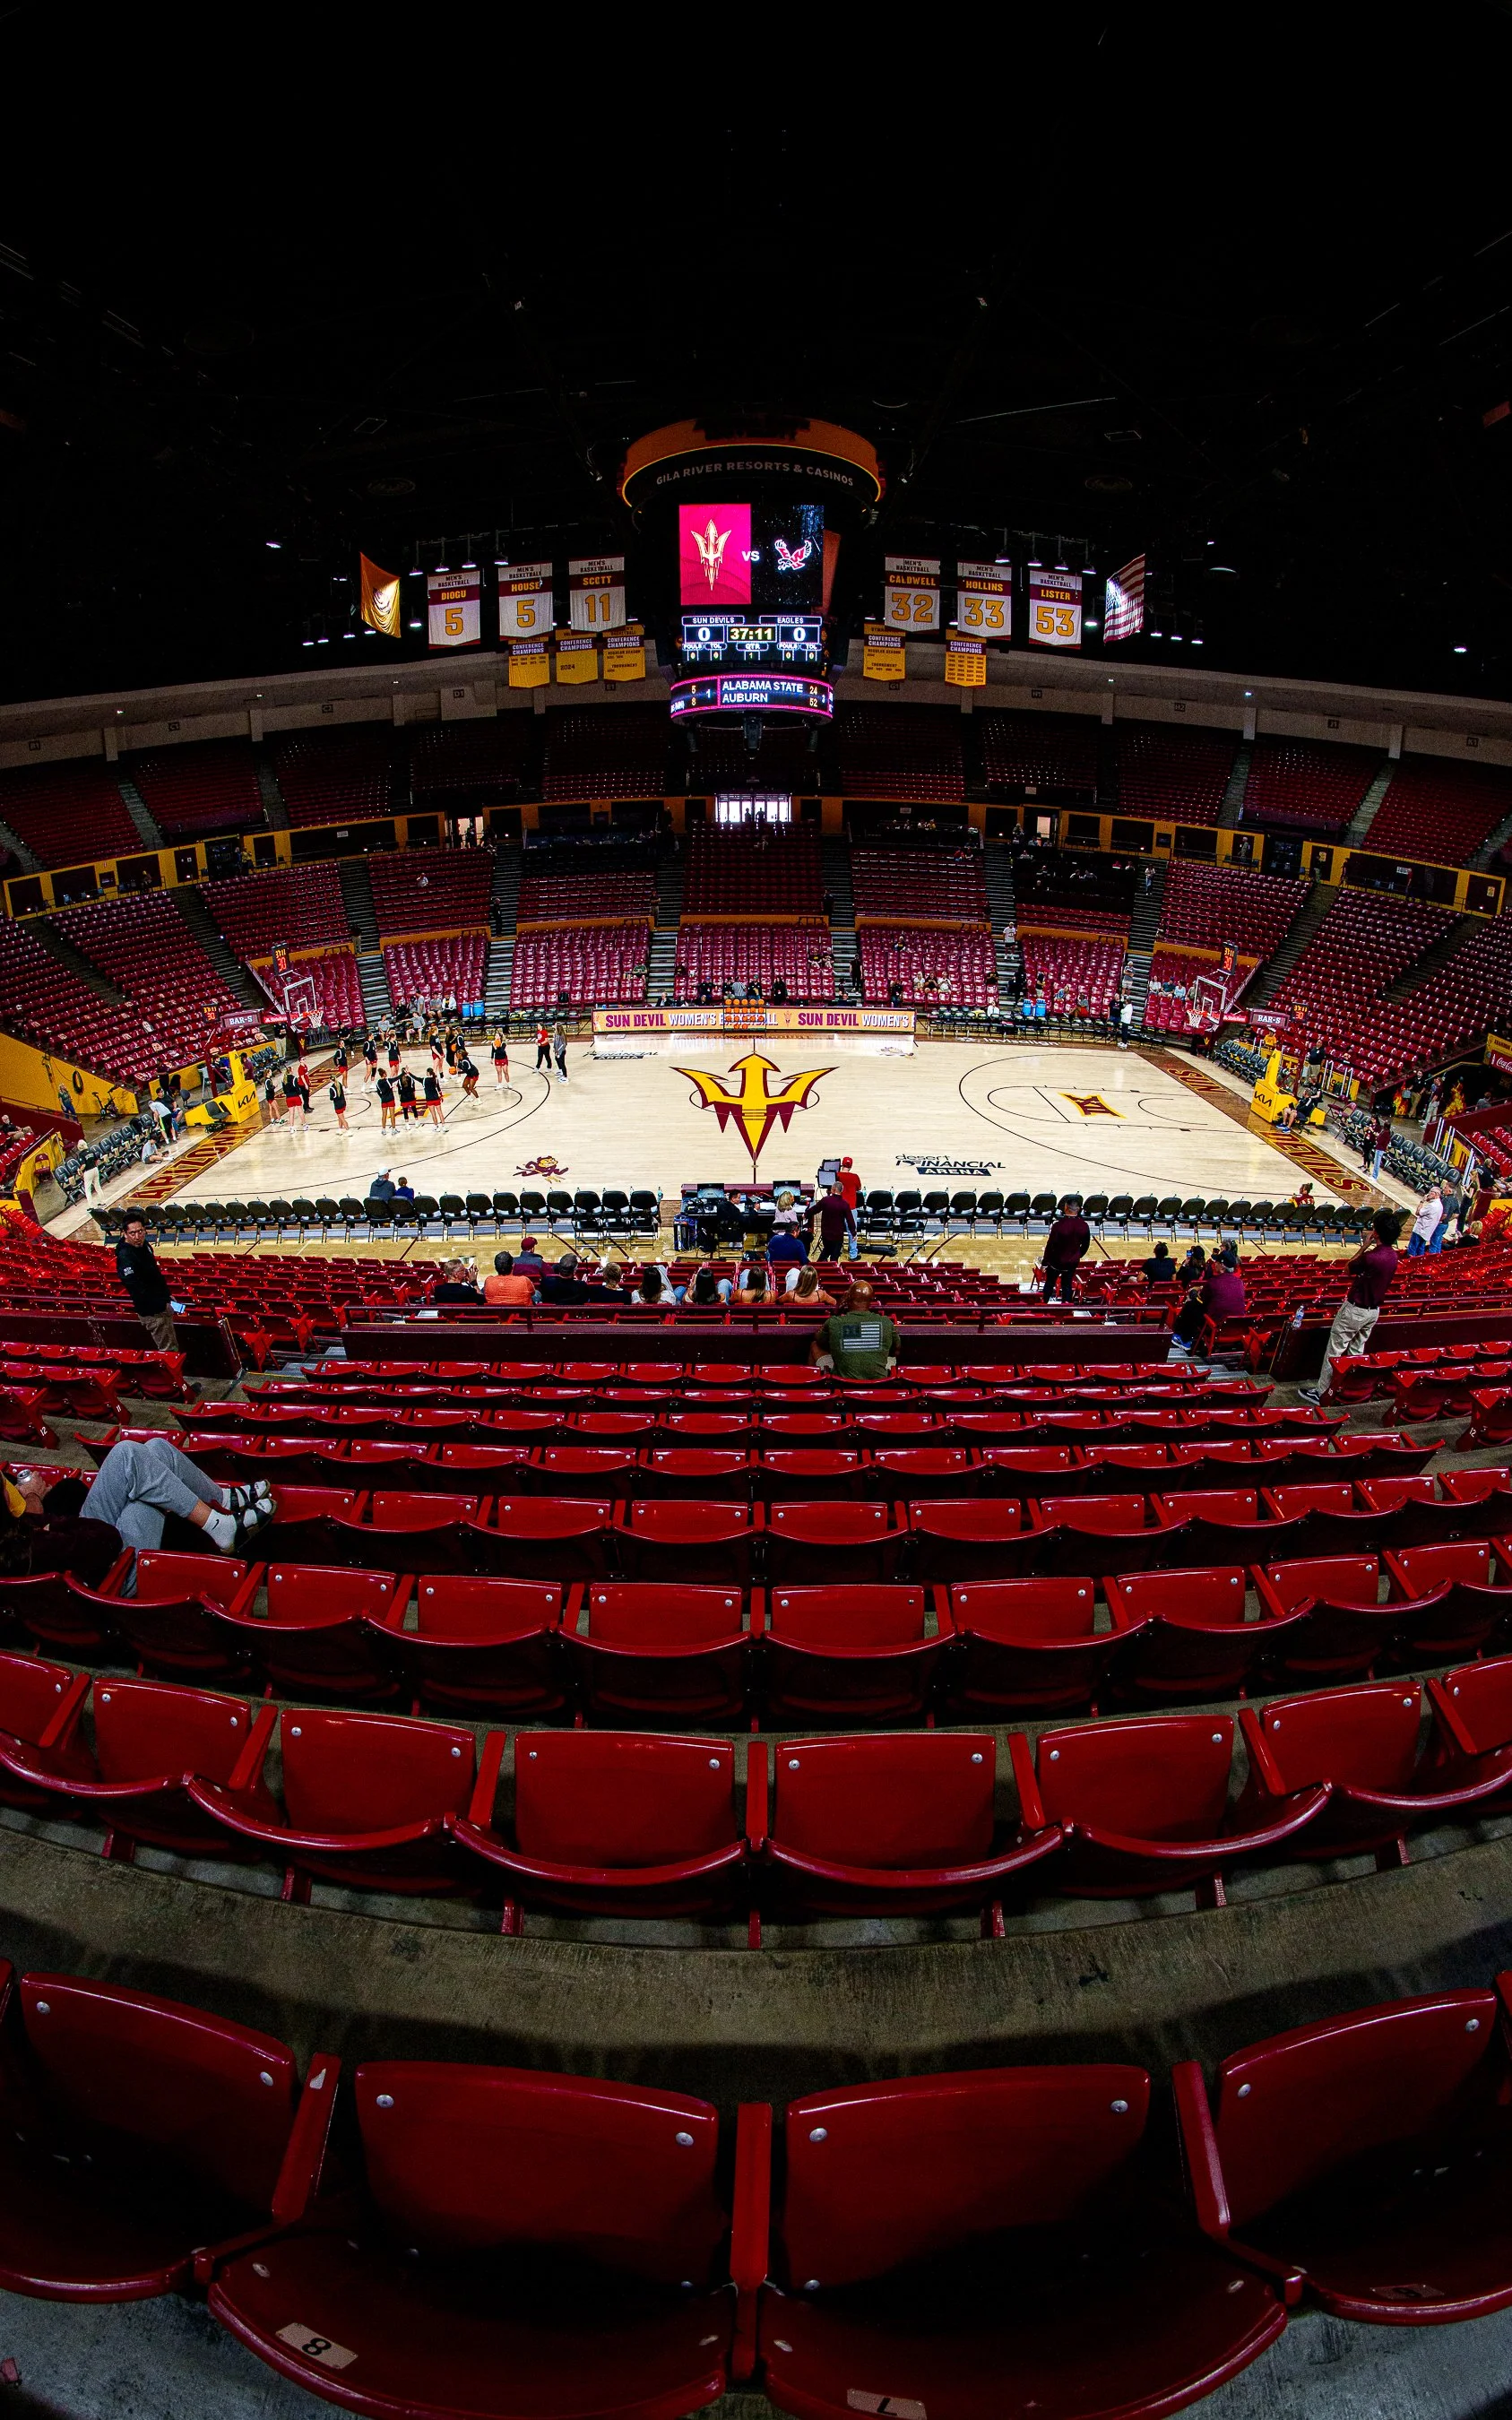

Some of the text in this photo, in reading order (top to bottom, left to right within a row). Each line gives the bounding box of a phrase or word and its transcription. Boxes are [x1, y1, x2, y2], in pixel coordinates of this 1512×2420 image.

[656, 462, 853, 486] GILA RIVER RESORTS & CASINOS
[741, 551, 760, 562] VS
[580, 565, 614, 573] BASKETBALL
[895, 565, 930, 573] BASKETBALL
[968, 570, 1001, 578] BASKETBALL
[445, 574, 462, 582] MEN'S
[508, 571, 541, 579] BASKETBALL
[583, 575, 612, 586] SCOTT
[889, 575, 937, 586] CALDWELL
[437, 579, 470, 588] BASKETBALL
[511, 582, 540, 592] HOUSE
[965, 580, 1004, 592] HOLLINS
[1040, 578, 1072, 588] BASKETBALL
[441, 590, 466, 601] DIOGU
[1041, 589, 1071, 601] LISTER
[585, 593, 610, 623] 11
[892, 592, 933, 623] 32
[964, 597, 1005, 628] 33
[516, 599, 536, 628] 5
[445, 607, 463, 636] 5
[1036, 605, 1075, 637] 53
[697, 627, 711, 642] 0
[730, 627, 773, 640] 37:11
[793, 627, 806, 642] 0
[868, 640, 901, 648] CHAMPIONS
[950, 641, 982, 649] CONFERENCE
[513, 647, 545, 655] CHAMPIONS
[950, 646, 982, 654] CHAMPIONS
[691, 685, 696, 695] 5
[705, 688, 711, 698] 1
[722, 680, 818, 696] ALABAMA STATE 24
[691, 696, 696, 706] 8
[722, 693, 768, 704] AUBURN
[809, 697, 818, 707] 52
[229, 1016, 253, 1025] BAR-S
[605, 1014, 630, 1028] SUN
[634, 1013, 666, 1027] DEVIL
[668, 1013, 716, 1026] WOMEN'S
[798, 1013, 823, 1026] SUN
[826, 1013, 859, 1026] DEVIL
[861, 1014, 909, 1028] WOMEN'S
[1257, 1015, 1282, 1024] BAR-S
[1167, 1068, 1231, 1094] SUN
[238, 1091, 256, 1109] KIA
[1255, 1091, 1272, 1108] KIA
[125, 1125, 263, 1200] ARIZONA
[902, 1160, 1007, 1168] FINANCIAL
[1255, 1130, 1372, 1193] DEVILS
[40, 1426, 48, 1437] 12
[1469, 1427, 1477, 1438] 12
[301, 2338, 332, 2356] 8
